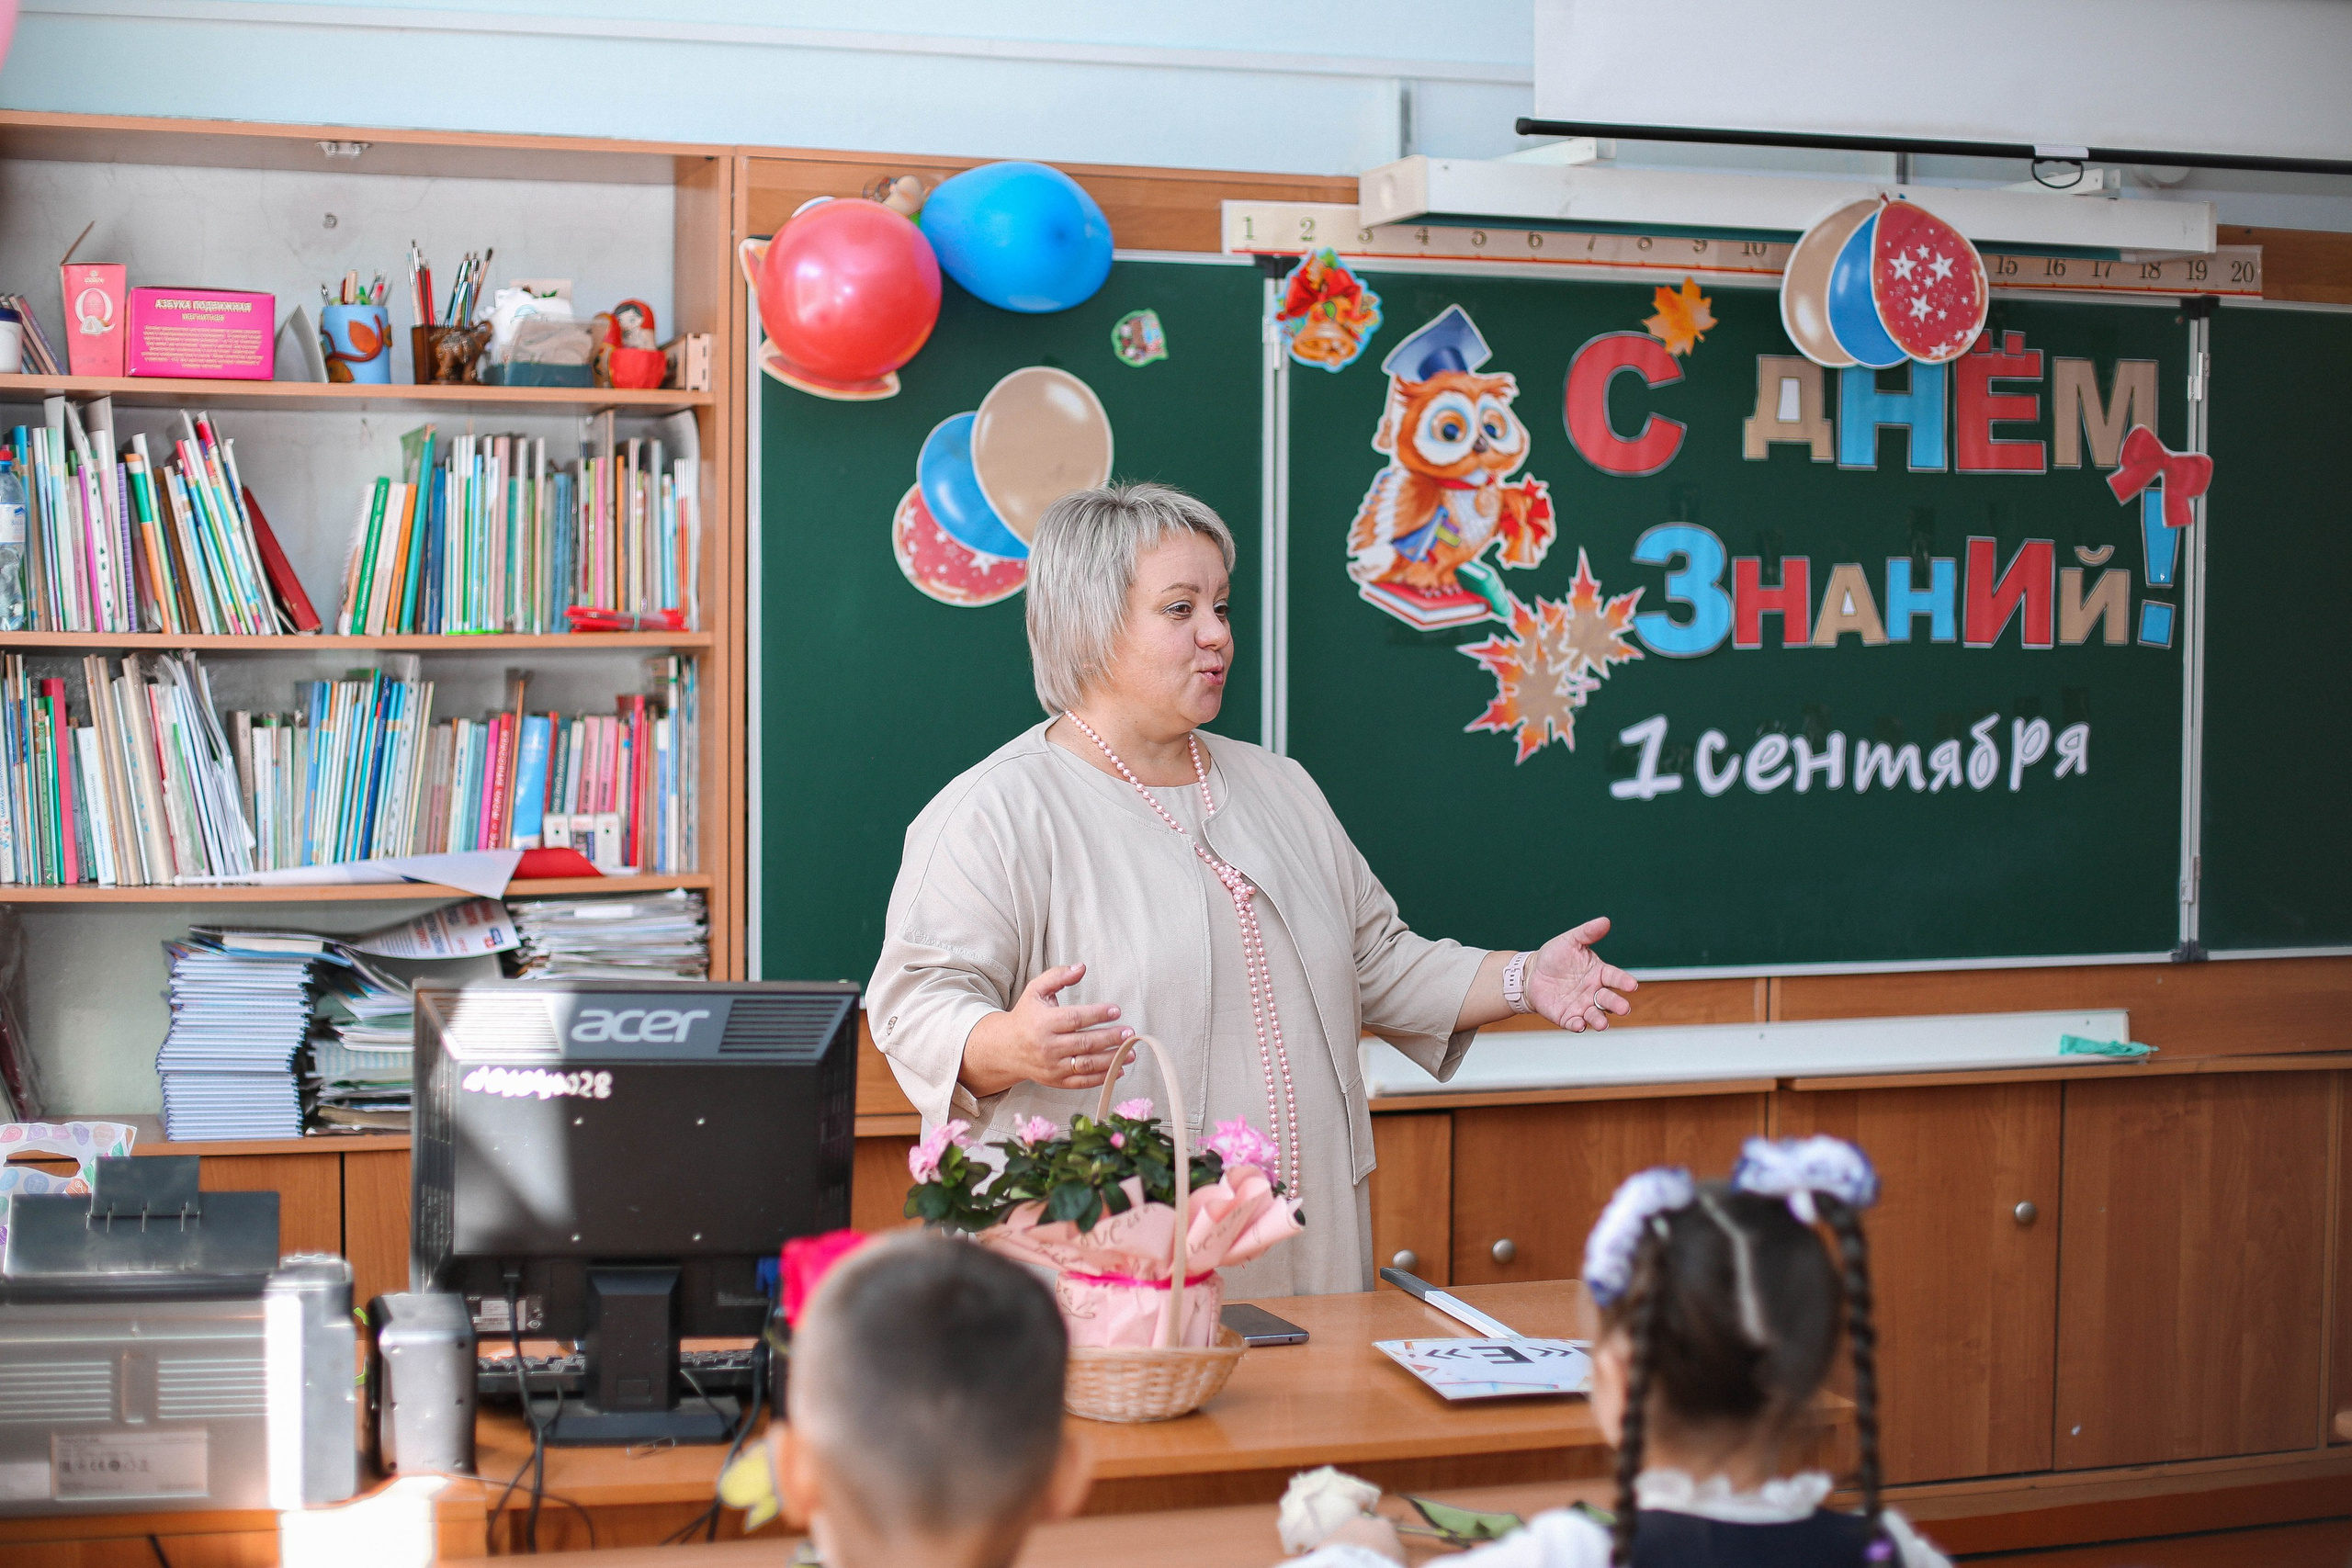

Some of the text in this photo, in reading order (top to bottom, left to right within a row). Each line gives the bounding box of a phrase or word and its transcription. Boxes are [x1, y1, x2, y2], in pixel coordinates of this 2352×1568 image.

[1244, 217, 1256, 241] 1
[1300, 217, 1315, 242] 2
[2187, 260, 2209, 281] 19
[2232, 261, 2254, 284] 20
[1563, 330, 2159, 478] С ДНЁМ
[1695, 712, 2090, 797] сентября
[571, 1009, 710, 1043] acer
